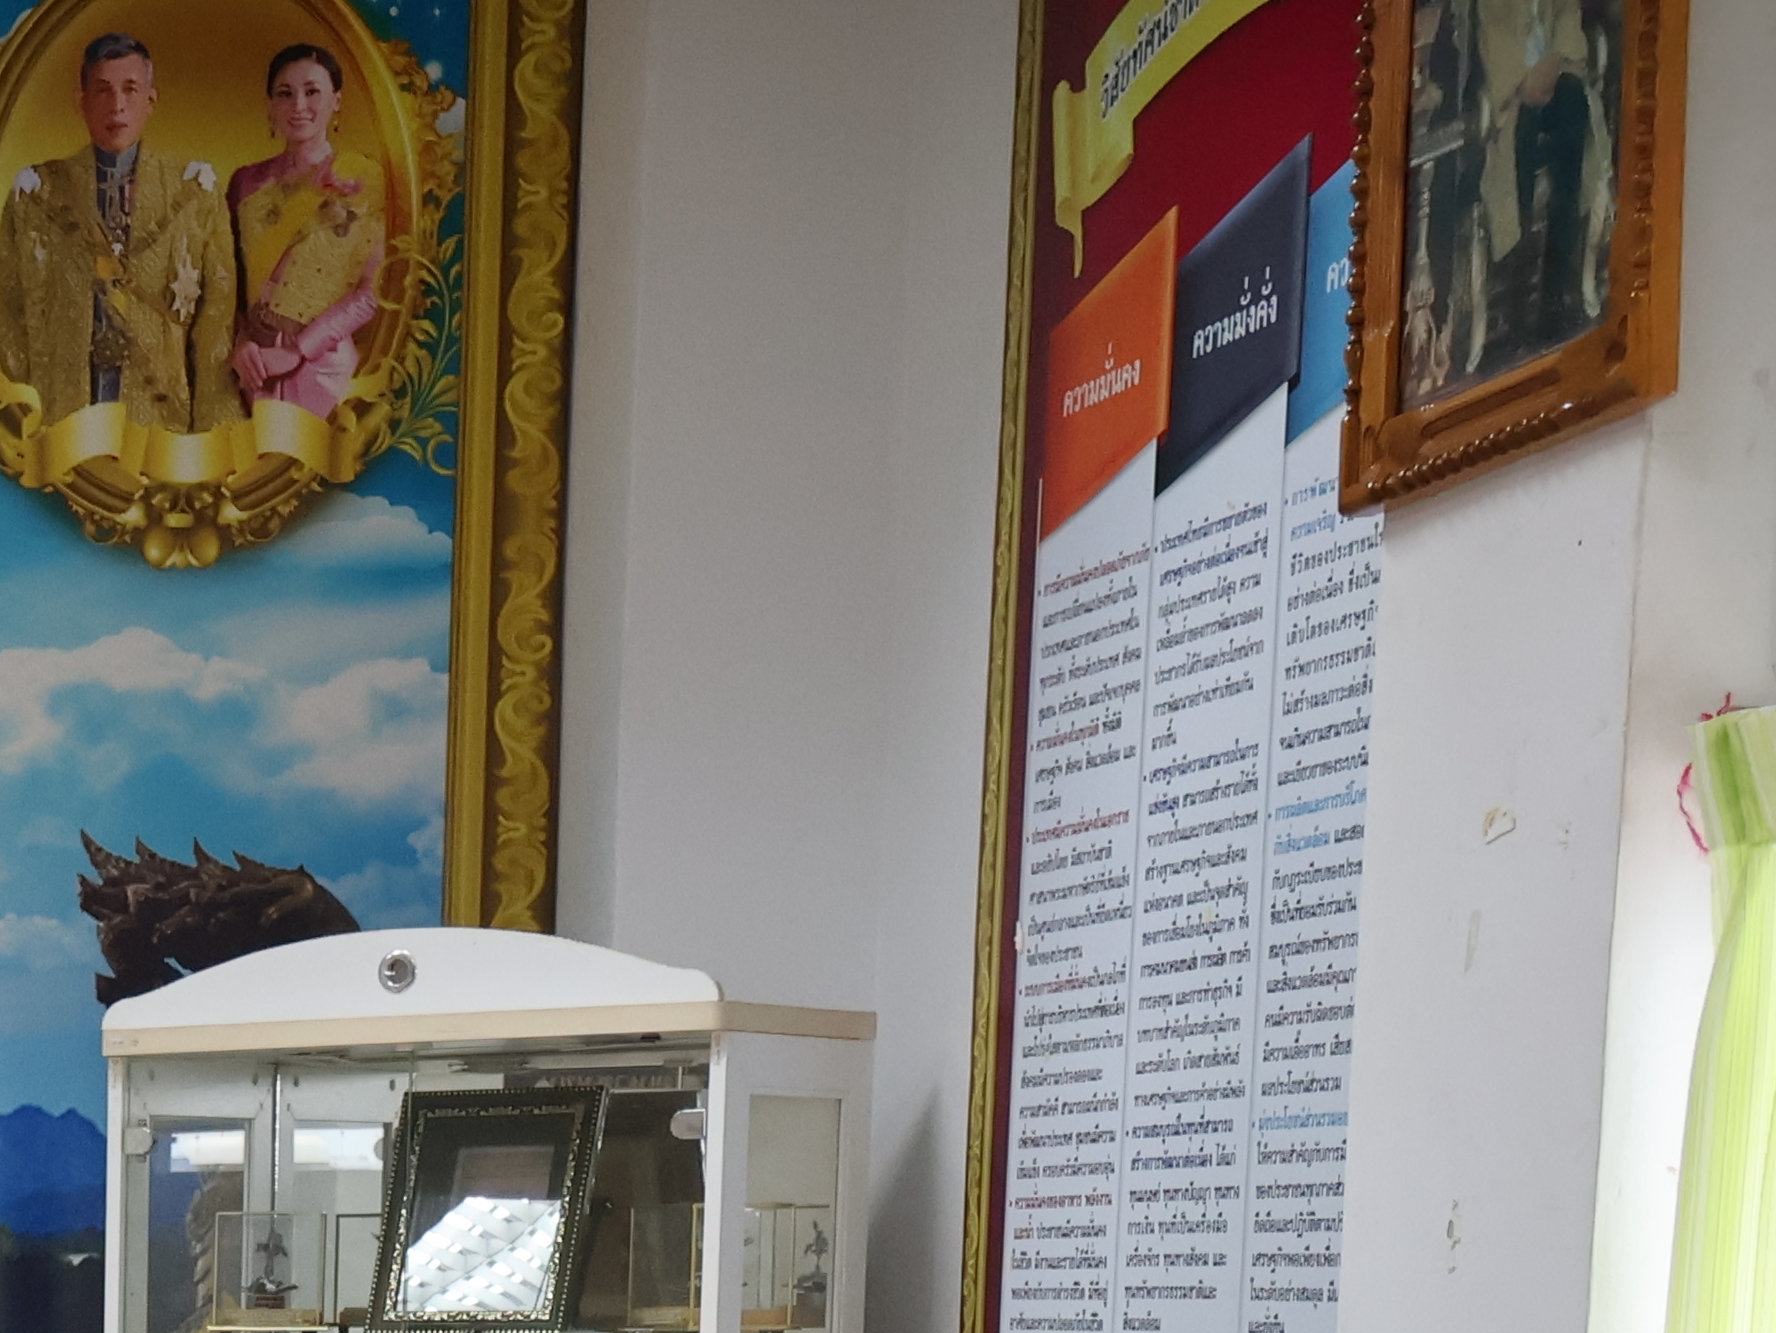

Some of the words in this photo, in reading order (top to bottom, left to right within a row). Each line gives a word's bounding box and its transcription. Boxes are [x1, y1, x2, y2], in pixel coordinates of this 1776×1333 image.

[1192, 266, 1278, 359] ความมั่งคั่ง
[1063, 343, 1142, 418] ความมั่นคง
